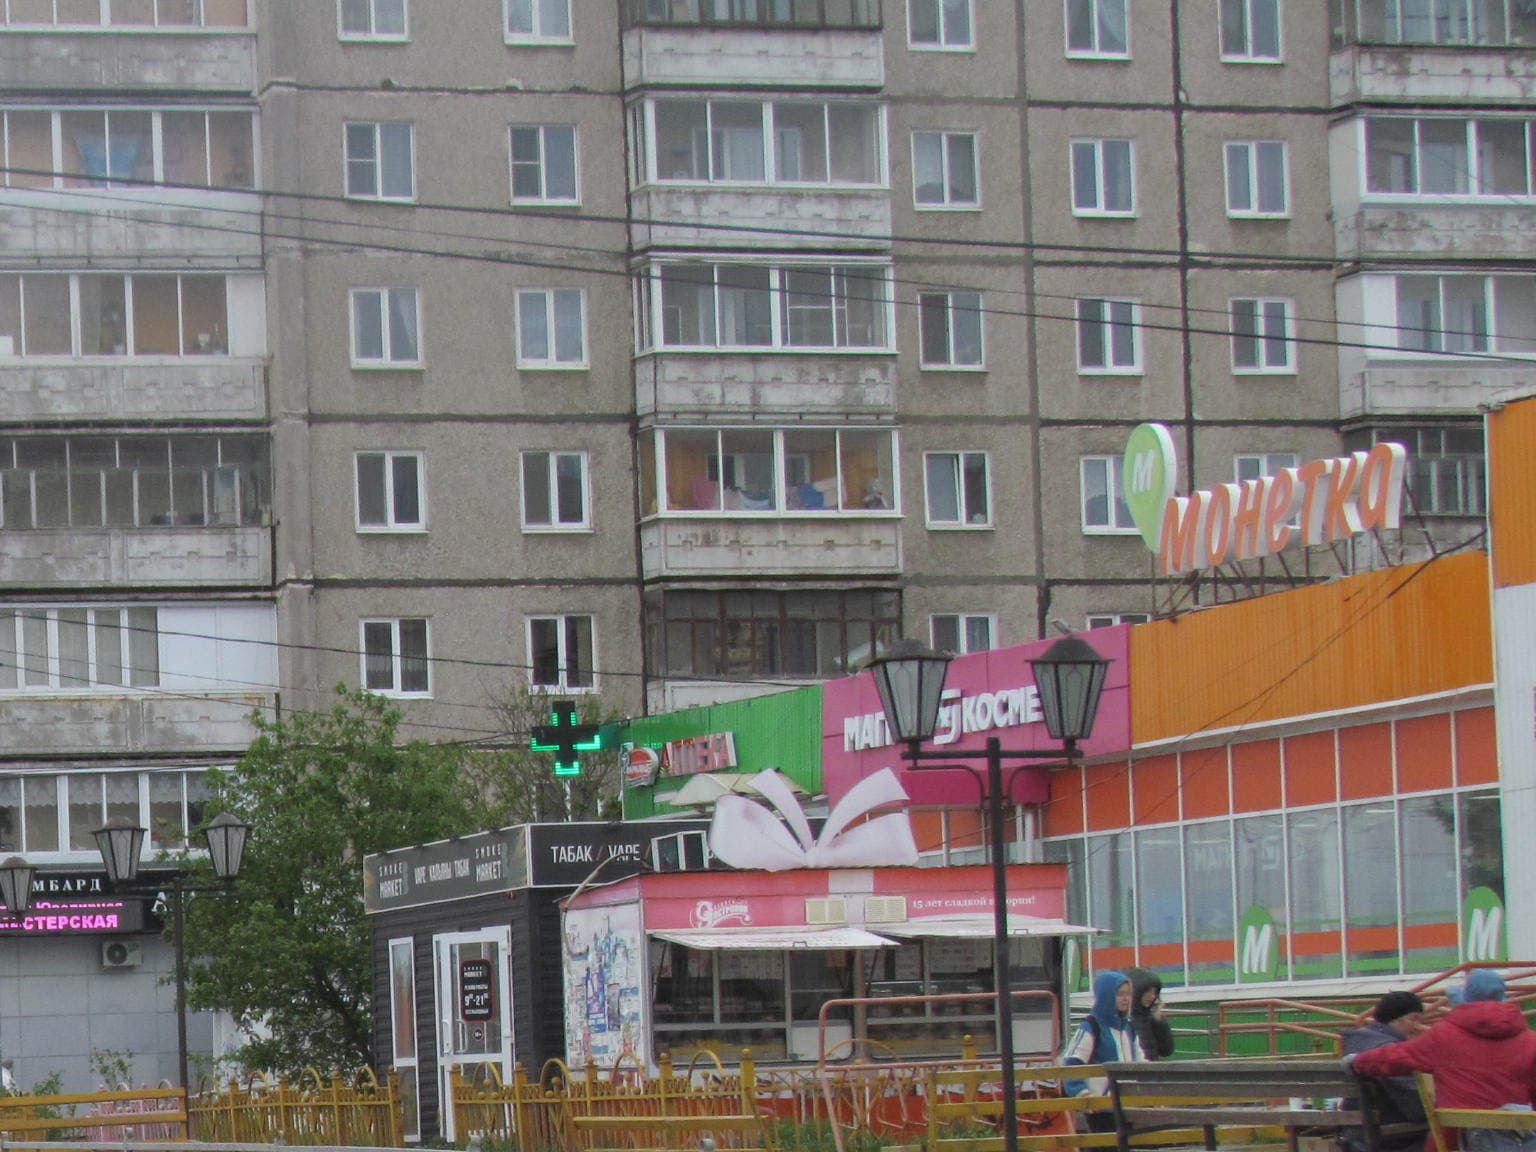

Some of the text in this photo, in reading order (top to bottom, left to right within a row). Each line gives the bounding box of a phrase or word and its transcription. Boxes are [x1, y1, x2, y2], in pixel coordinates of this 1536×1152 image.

[844, 685, 1044, 752] МАГ КОСМЕ
[475, 843, 502, 860] SMOKE
[550, 843, 641, 864] ТАБАК VAPE
[378, 862, 404, 877] SMOKE
[475, 860, 502, 883] MARKET
[30, 878, 101, 893] МБАРД
[378, 878, 403, 899] MARKET
[944, 897, 987, 907] сладкой
